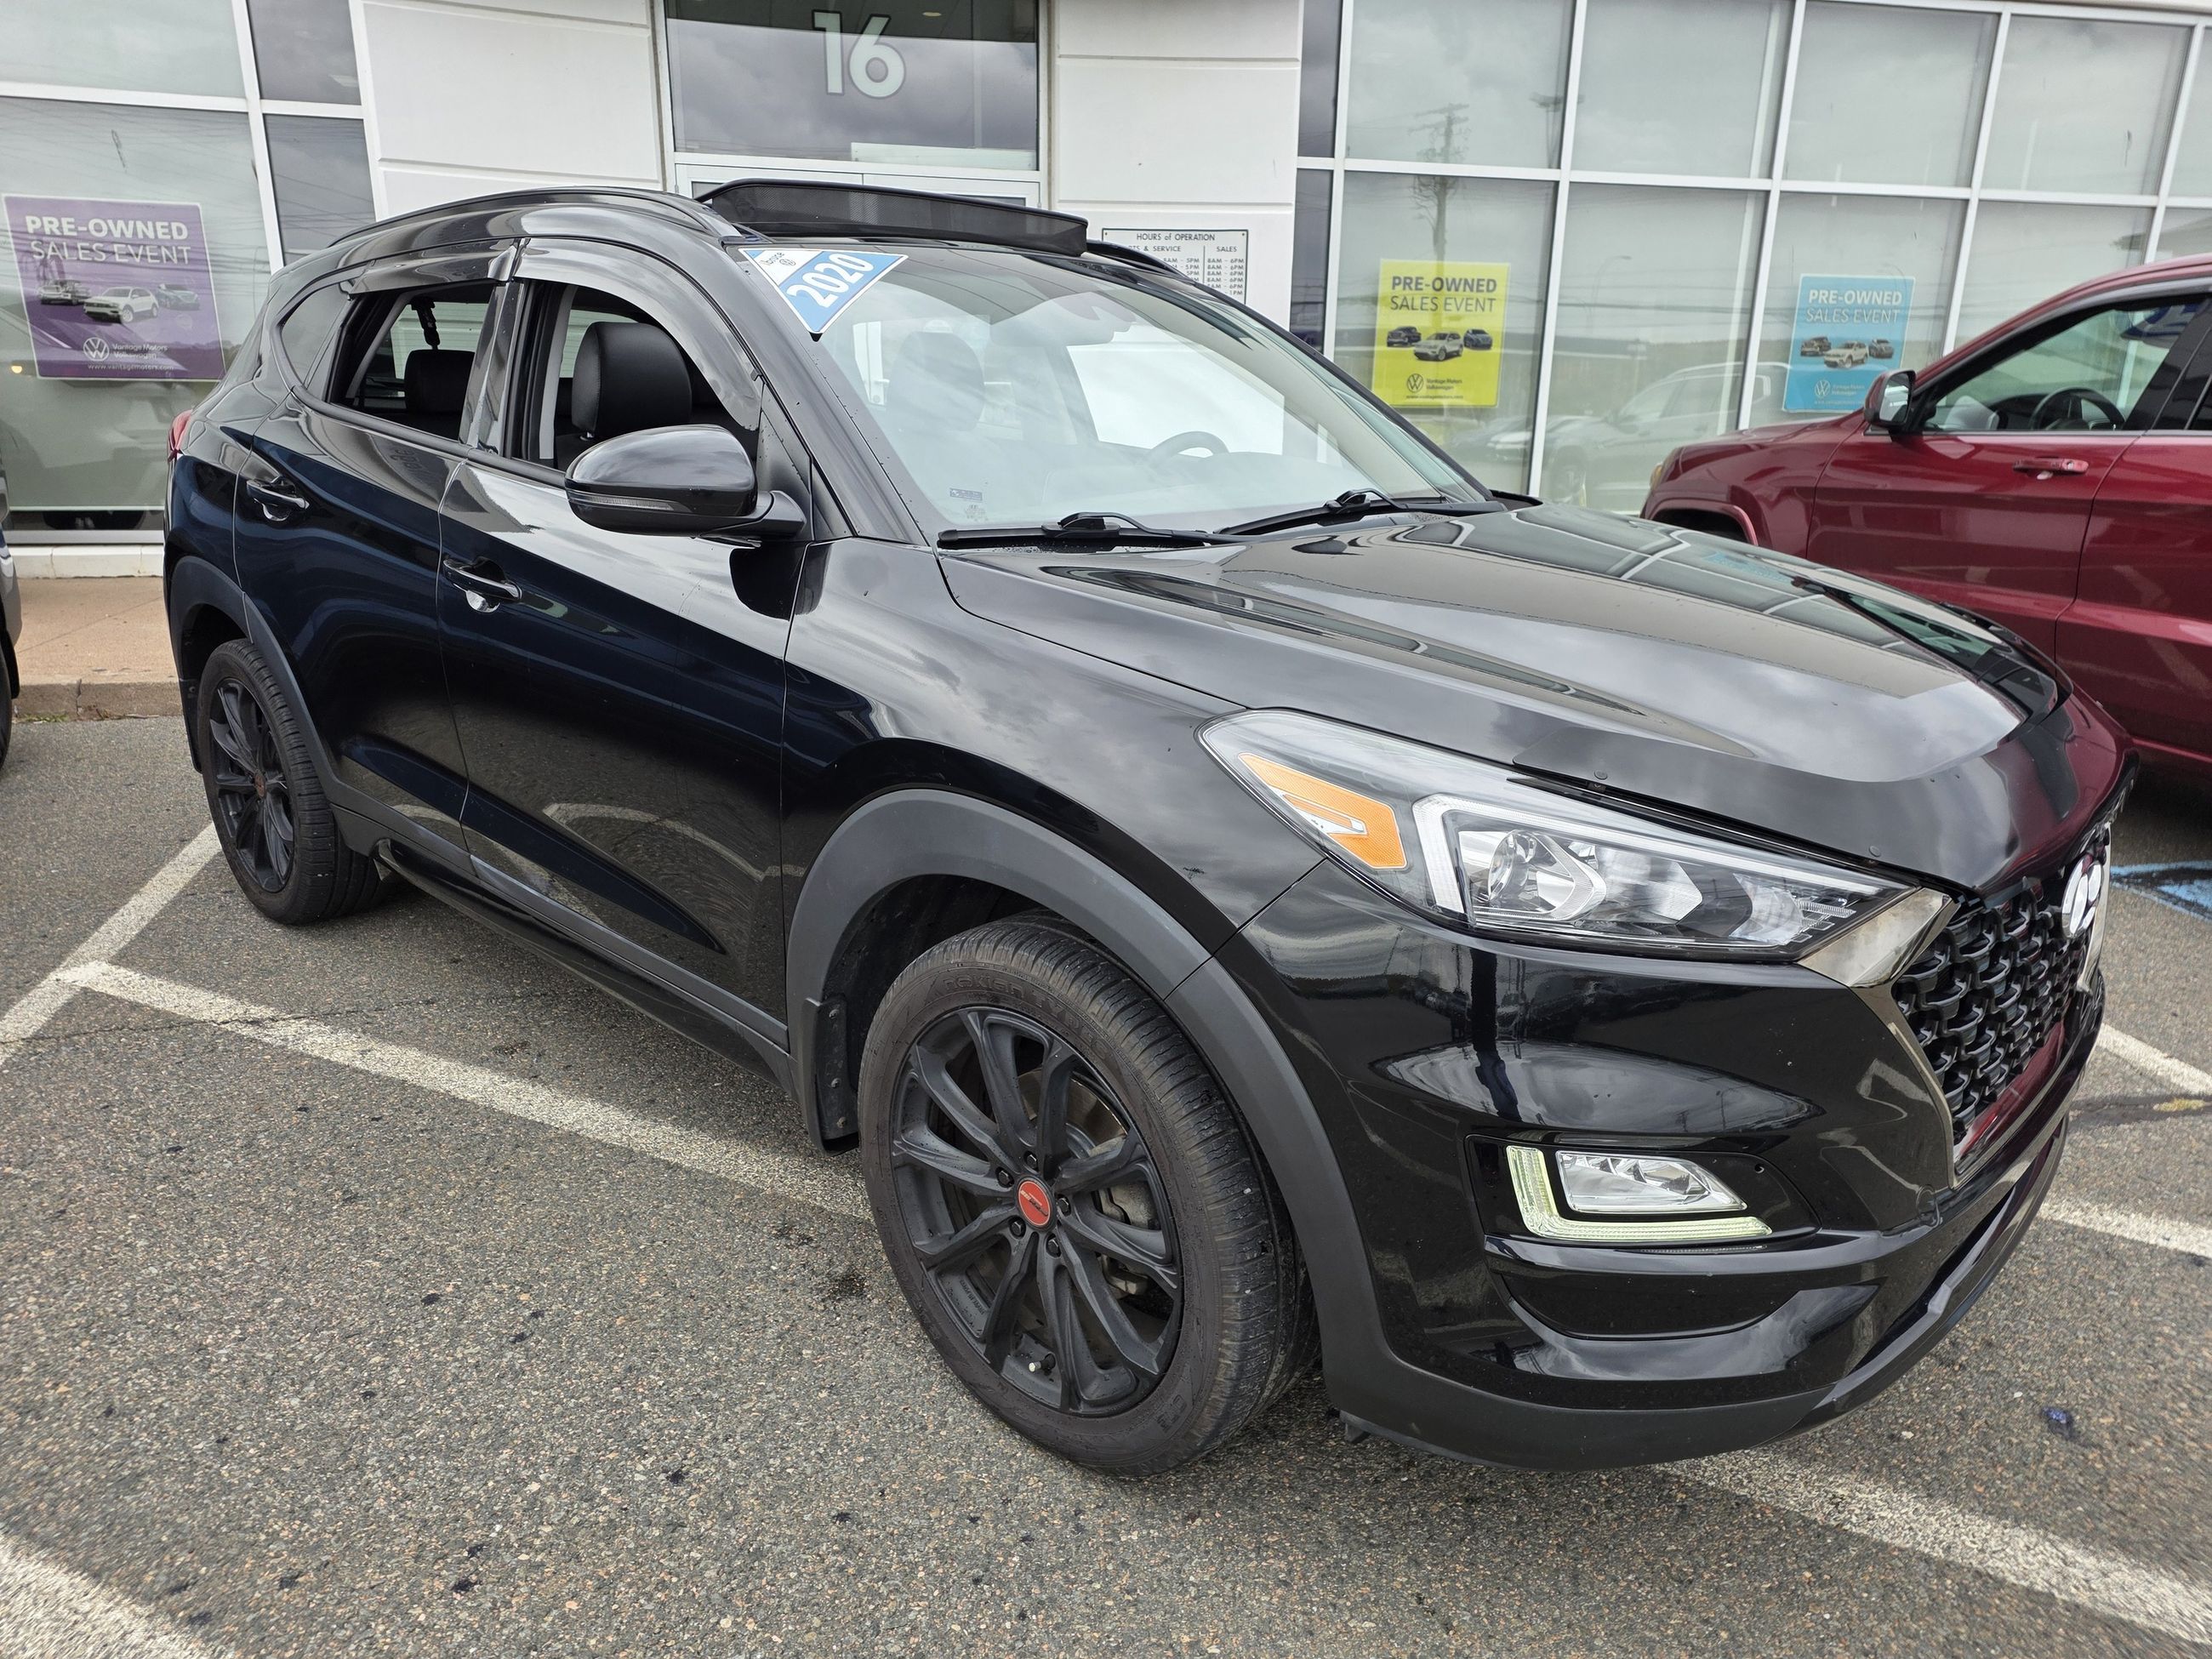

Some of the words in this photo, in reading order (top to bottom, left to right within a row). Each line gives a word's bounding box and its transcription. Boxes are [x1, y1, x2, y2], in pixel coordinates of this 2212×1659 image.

[812, 9, 907, 100] 16
[26, 215, 189, 240] PRE-OWNED
[31, 241, 106, 262] SALES
[115, 243, 191, 265] EVENT
[786, 254, 875, 308] 2020
[1391, 276, 1497, 293] PRE-OWNED
[1390, 295, 1439, 311] SALES
[1443, 297, 1497, 312] EVENT
[1809, 289, 1903, 305] PRE-OWNED
[1806, 308, 1850, 323] SALES
[1854, 309, 1901, 323] EVENT
